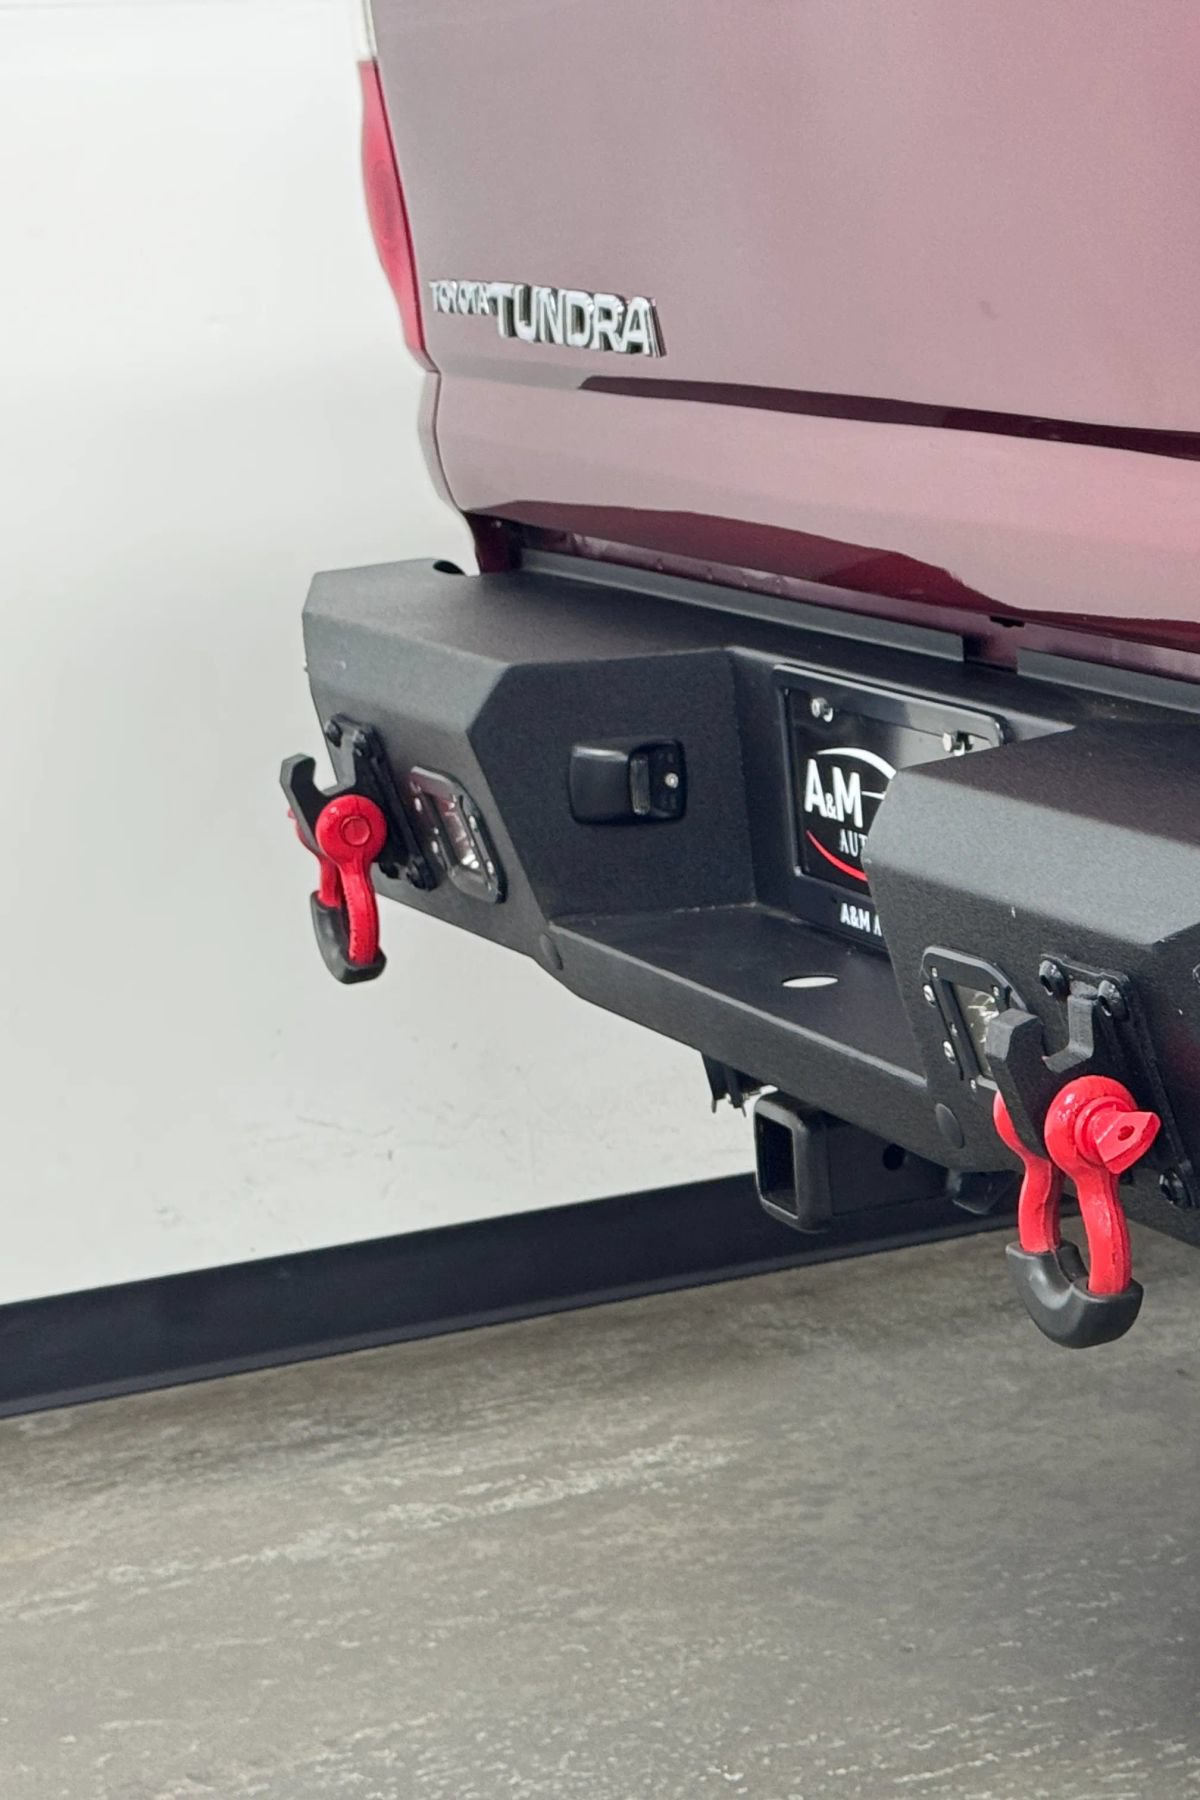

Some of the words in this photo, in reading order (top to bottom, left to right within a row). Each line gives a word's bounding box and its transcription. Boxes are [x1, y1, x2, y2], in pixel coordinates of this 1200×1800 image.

[488, 281, 666, 358] TUNDRA
[803, 758, 864, 828] A&M
[839, 902, 872, 933] A&M
